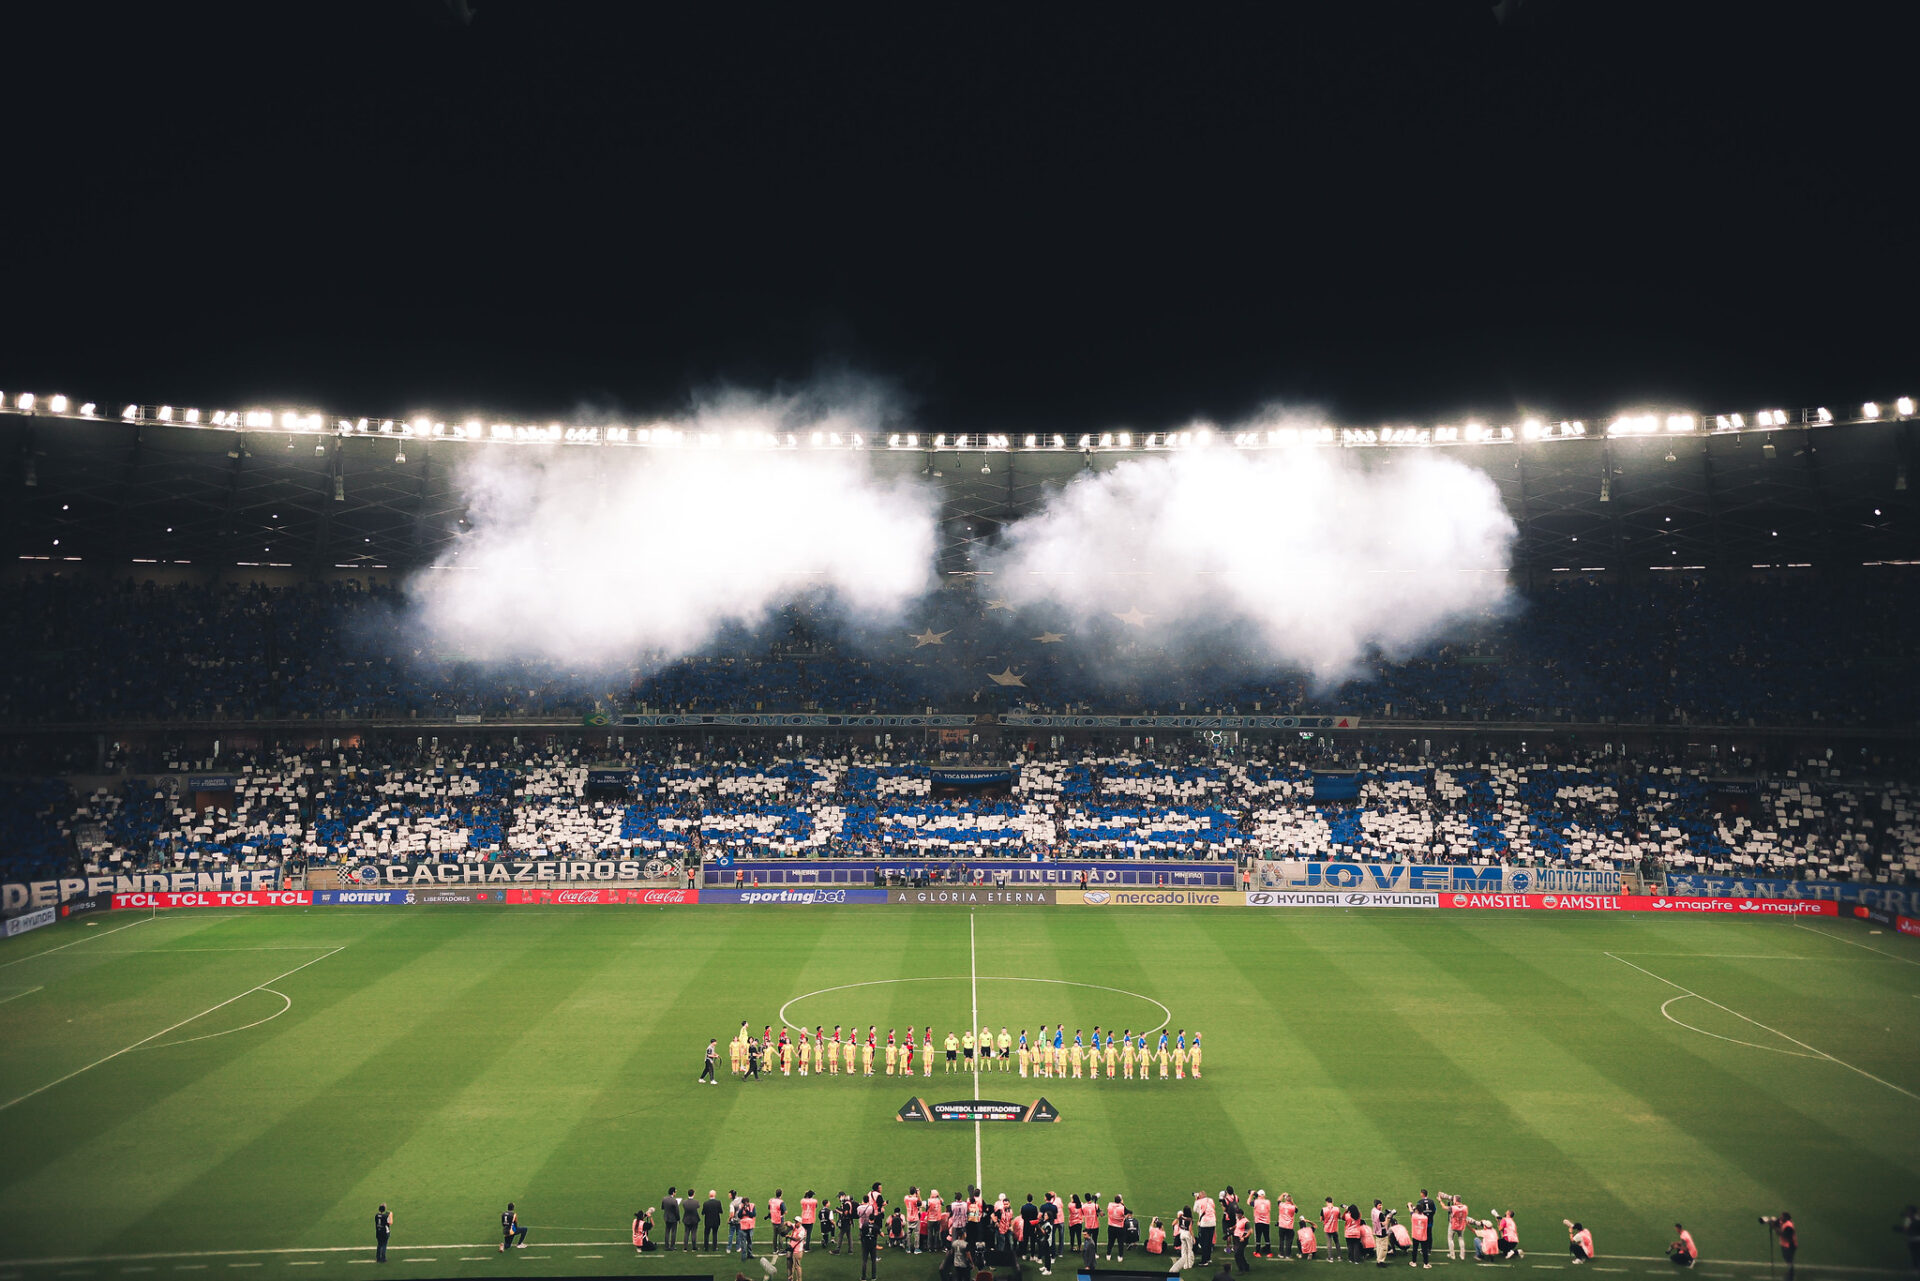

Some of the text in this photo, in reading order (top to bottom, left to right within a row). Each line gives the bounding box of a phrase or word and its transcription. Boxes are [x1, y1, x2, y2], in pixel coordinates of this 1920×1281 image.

[713, 714, 829, 726] SOMOS
[840, 715, 968, 726] LOUCOS
[1005, 715, 1301, 728] SOMOS CRUZEIRO
[385, 861, 640, 885] CACHAZEIROS
[1291, 862, 1504, 892] JOVEM
[1535, 867, 1622, 893] MOTOZEIROS
[116, 894, 159, 907] TCL
[167, 894, 209, 906] TCL
[217, 893, 259, 905] TCL
[266, 892, 309, 904] TCL
[339, 892, 391, 903] NOTIFUT
[740, 889, 847, 905] sportingbet
[898, 891, 1046, 902] A GLÓRIA ETERNA
[1115, 892, 1220, 904] mercado livre
[1277, 893, 1340, 905] HYUNDAI
[1372, 894, 1437, 905] HYUNDAI
[1469, 894, 1531, 908] AMSTEL
[1558, 896, 1622, 910] AMSTEL
[1675, 899, 1733, 911] mapfre
[1762, 901, 1821, 915] mapfre
[23, 907, 56, 929] HYUNDAI
[973, 1105, 1021, 1113] LIBERTADORES
